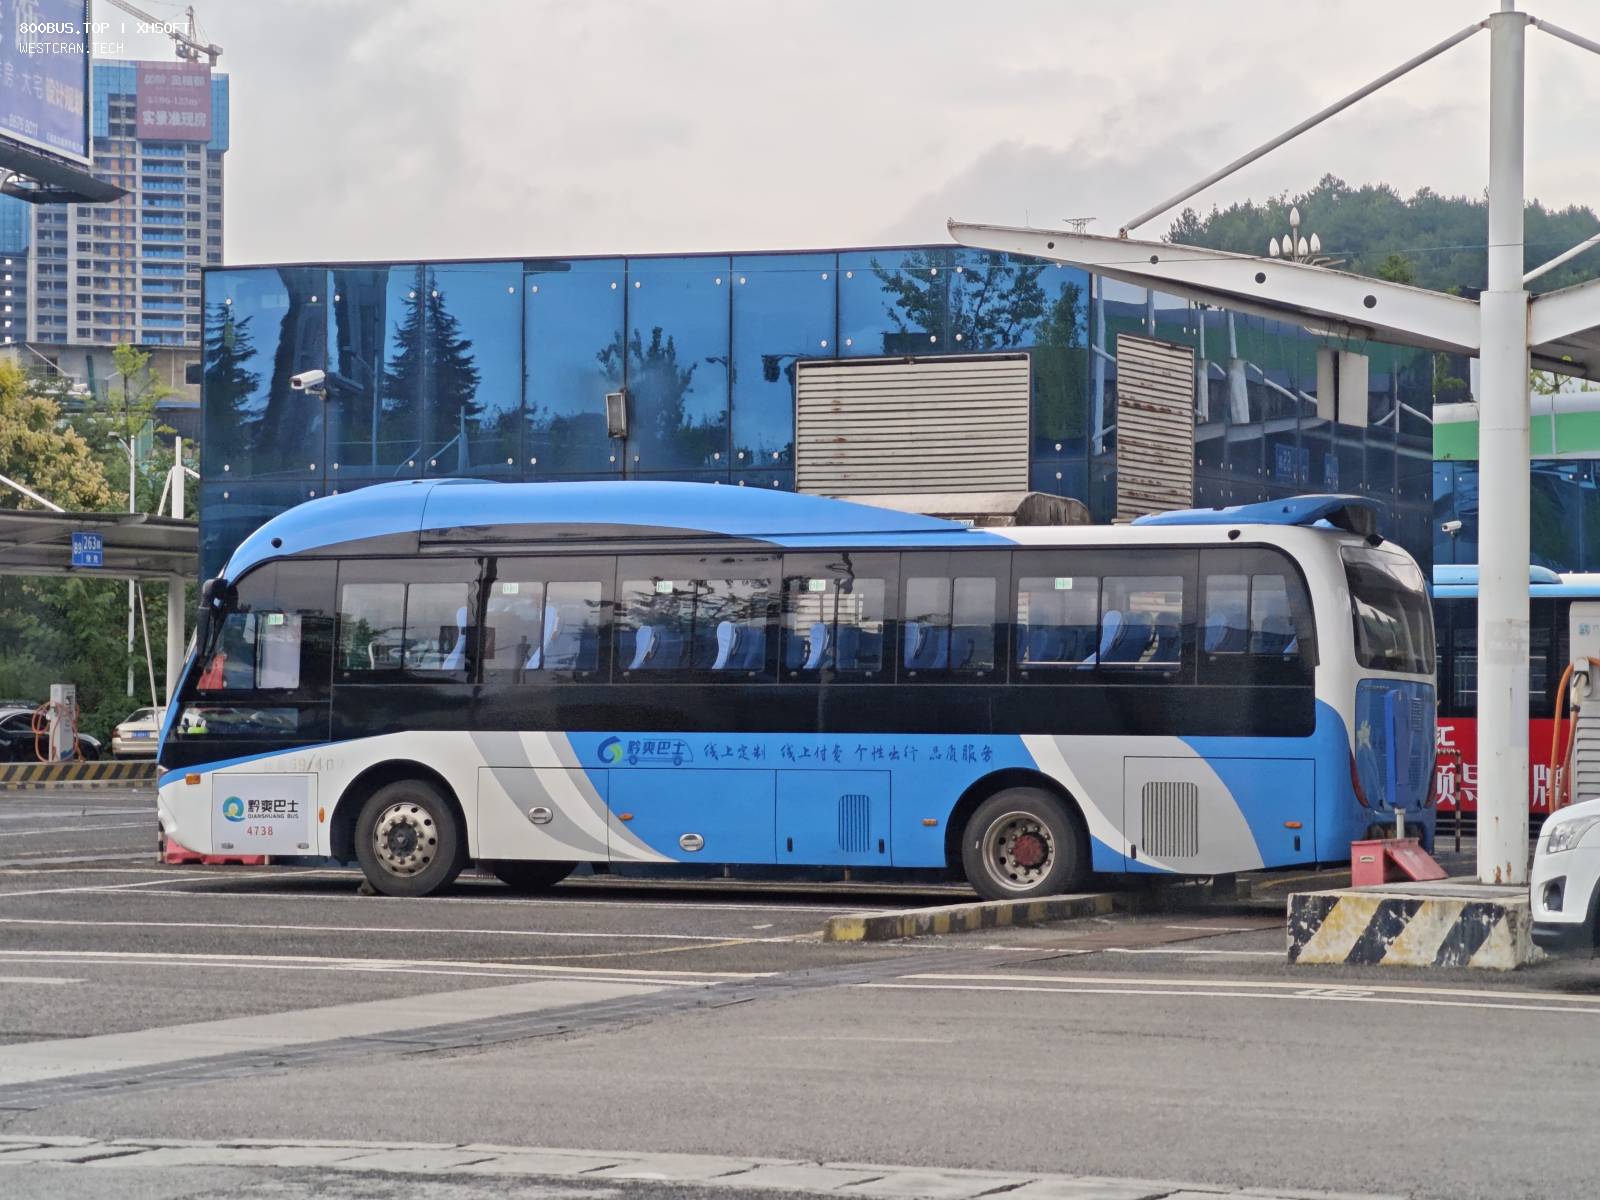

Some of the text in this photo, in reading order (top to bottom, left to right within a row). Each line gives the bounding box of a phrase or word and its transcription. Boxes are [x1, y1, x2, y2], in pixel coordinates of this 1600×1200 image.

[627, 740, 685, 755] 黔爽巴士
[703, 742, 993, 763] 线上定制 线上付费 个性出行 品质服务
[247, 799, 299, 813] 黔爽巴士
[247, 826, 273, 836] 4738
